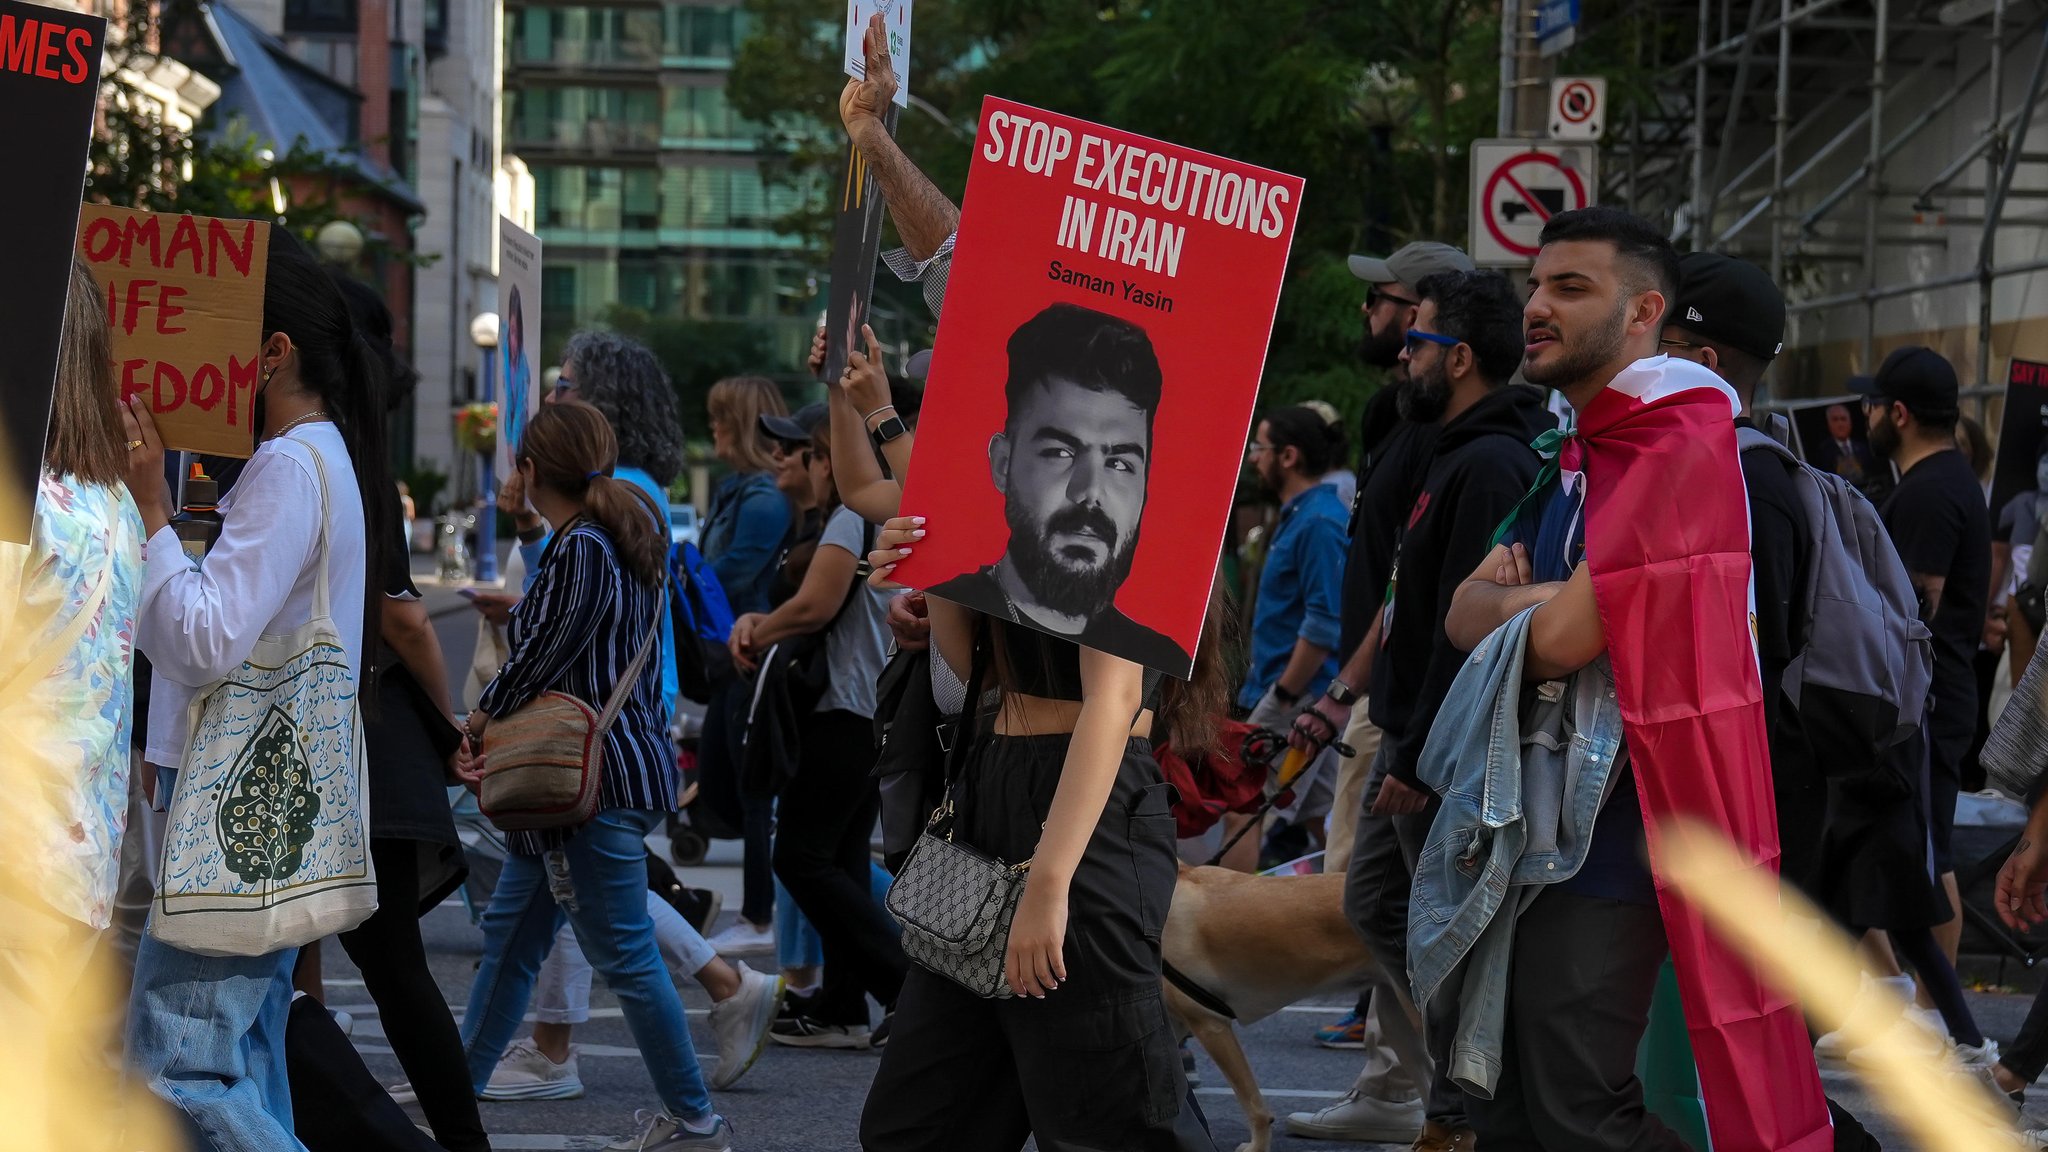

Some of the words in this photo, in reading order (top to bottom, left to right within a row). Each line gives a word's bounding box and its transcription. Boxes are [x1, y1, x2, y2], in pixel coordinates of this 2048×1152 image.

[0, 14, 93, 84] MES
[983, 110, 1073, 178] STOP
[1073, 133, 1290, 239] EXECUTIONS
[82, 214, 255, 278] OMAN
[1056, 195, 1098, 253] IN
[1098, 206, 1186, 278] IRAN
[107, 278, 189, 337] IFE
[1047, 260, 1115, 297] Saman
[1122, 279, 1174, 313] Yasin
[113, 353, 259, 434] EDOM
